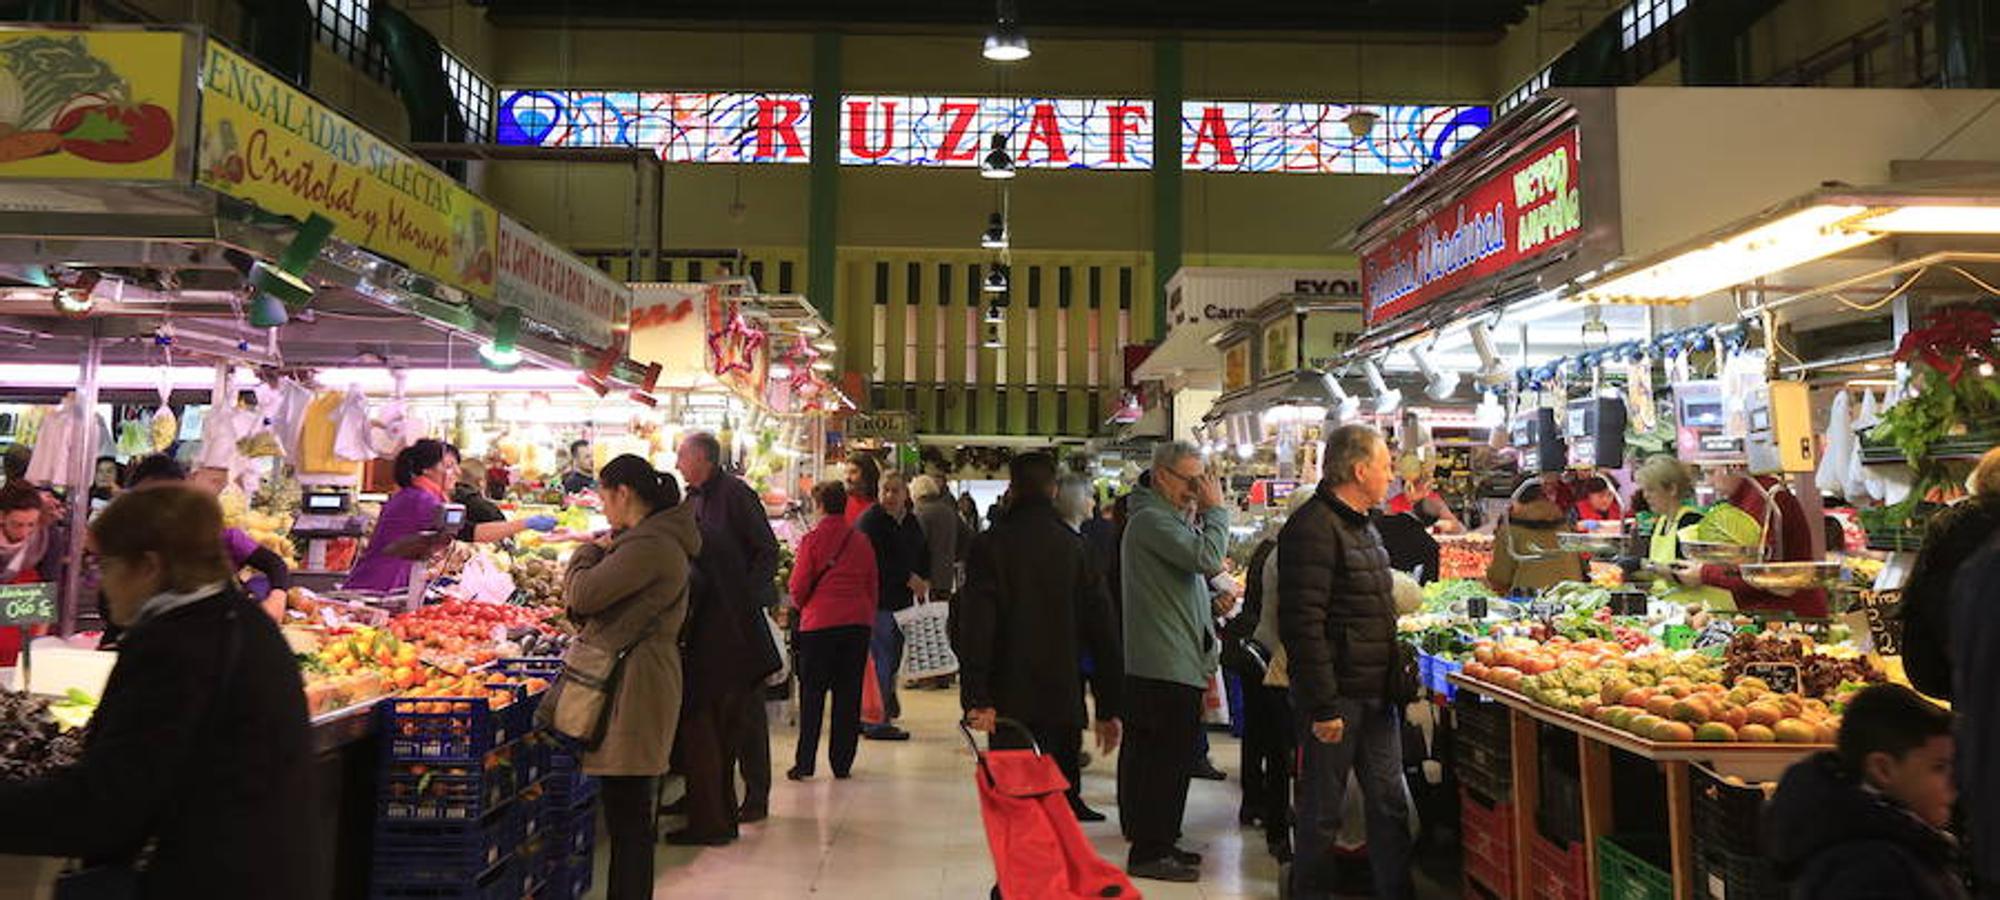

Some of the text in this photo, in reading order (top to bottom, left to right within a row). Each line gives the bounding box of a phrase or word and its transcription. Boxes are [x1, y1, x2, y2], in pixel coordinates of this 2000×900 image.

[204, 51, 453, 216] ENSALADAS SELECTAS
[755, 98, 1239, 165] RUZAFA
[362, 208, 377, 246] y
